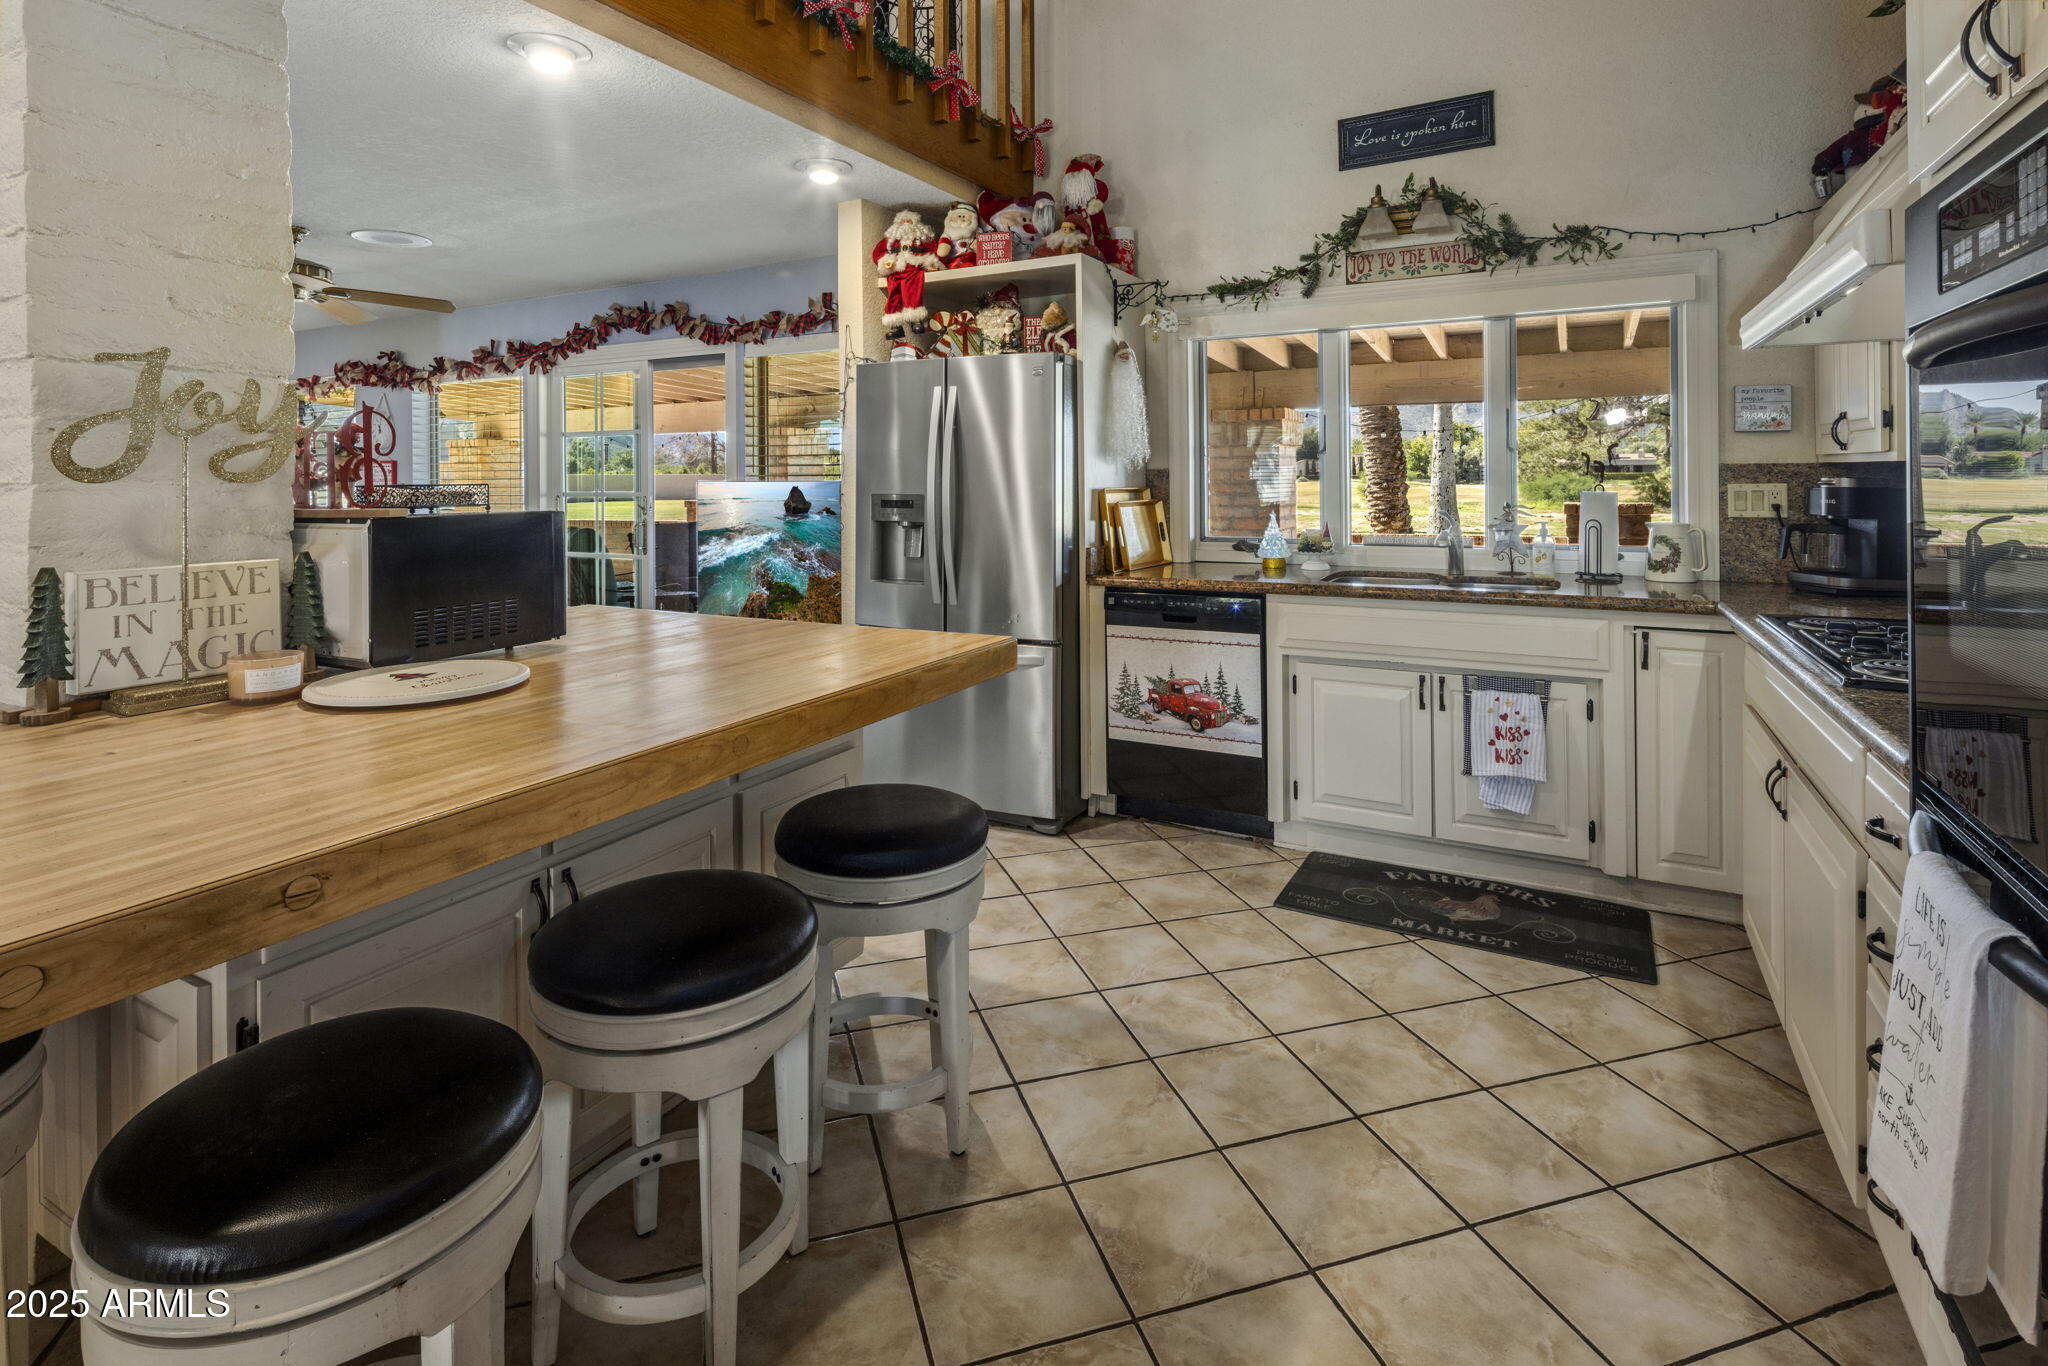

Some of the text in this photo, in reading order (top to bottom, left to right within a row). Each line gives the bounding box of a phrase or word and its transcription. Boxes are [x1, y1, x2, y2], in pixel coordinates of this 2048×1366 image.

[1354, 110, 1478, 147] Love is spoken here
[1349, 243, 1481, 280] JOY TO THE WORLD
[1025, 318, 1041, 326] THE
[1025, 326, 1042, 340] ELF
[50, 346, 328, 485] Joy
[112, 602, 248, 639] IN THE
[84, 629, 275, 688] MAGIC
[1494, 725, 1524, 743] KISS
[1494, 747, 1524, 766] KISS
[1382, 870, 1557, 908] FARMERS
[1391, 916, 1519, 948] MARKET
[1914, 885, 1947, 948] LIFE IS
[1563, 952, 1640, 974] PRODUCE
[1576, 949, 1628, 965] FRESH
[1892, 968, 1944, 1053] JUST ADD
[1885, 1020, 1937, 1087] water
[1877, 1109, 1901, 1141] north
[1878, 1085, 1930, 1163] AKE SUPERIOR
